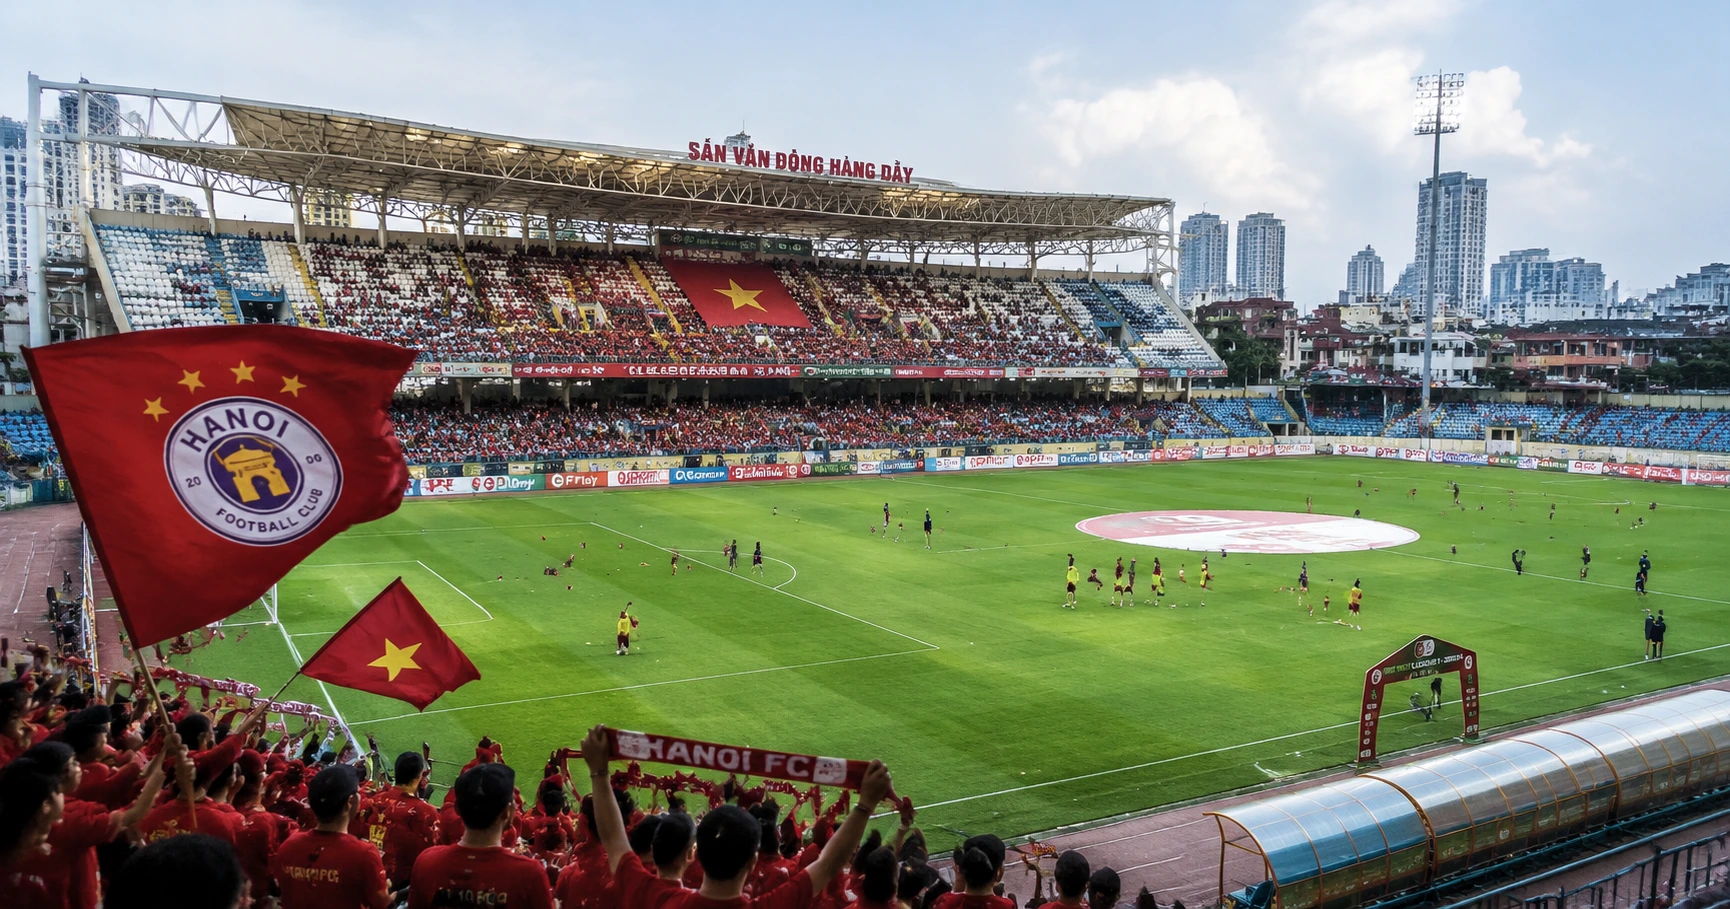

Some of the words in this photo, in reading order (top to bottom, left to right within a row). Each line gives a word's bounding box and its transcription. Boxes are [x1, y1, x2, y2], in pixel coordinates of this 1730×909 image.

[180, 408, 290, 453] HANOI
[185, 476, 202, 488] 20
[216, 508, 299, 533] FOOTBALL
[298, 488, 323, 518] CLUB
[649, 738, 752, 772] HANOI
[764, 753, 810, 778] FC
